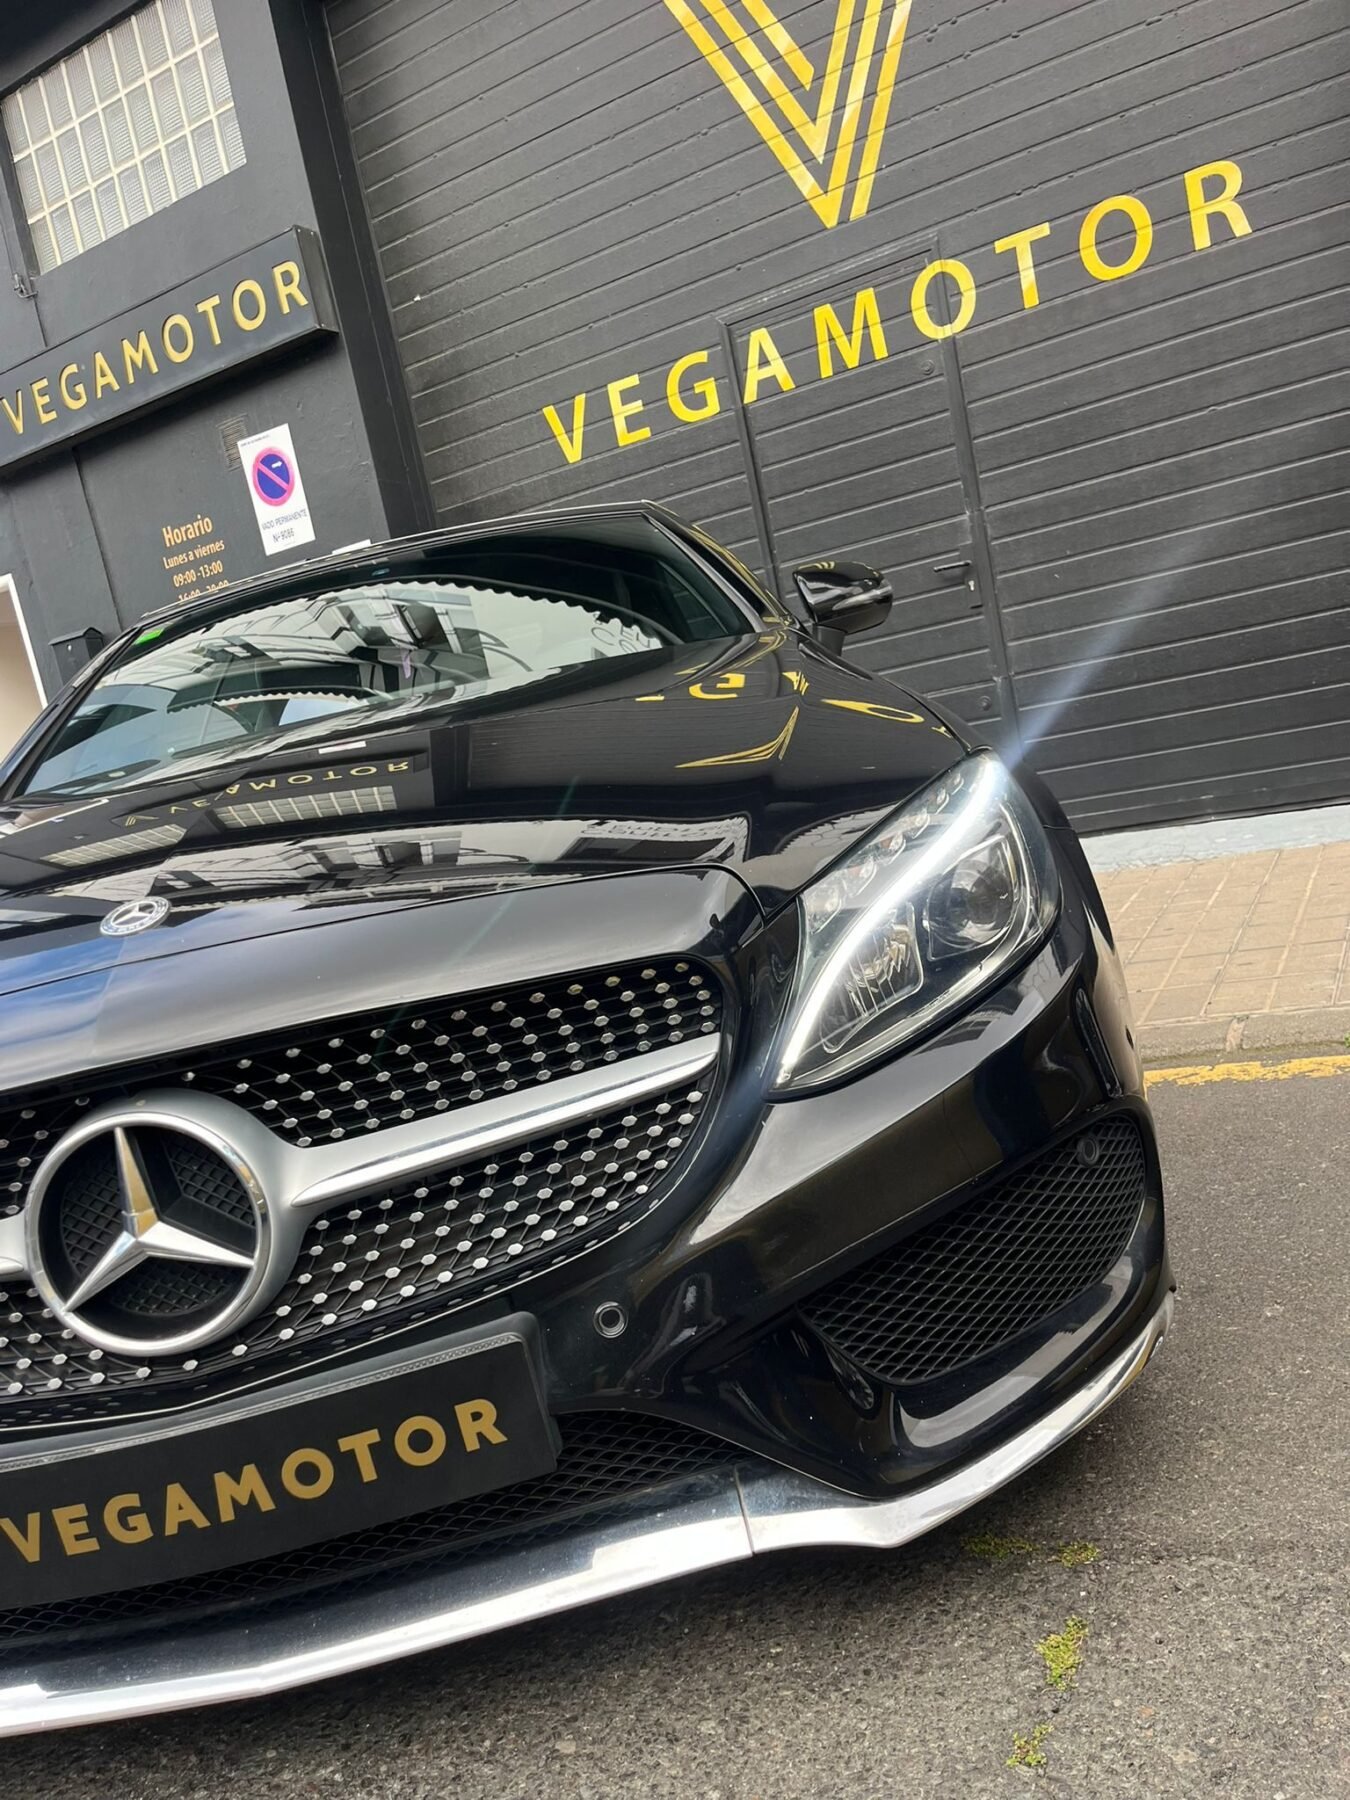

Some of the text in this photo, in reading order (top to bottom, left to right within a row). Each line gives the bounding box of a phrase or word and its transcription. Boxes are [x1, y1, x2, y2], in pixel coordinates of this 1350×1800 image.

[0, 260, 309, 435] VEGAMOTOR
[542, 160, 1251, 464] VEGAMOTOR
[162, 514, 213, 547] Horario
[162, 540, 225, 569] Lunes a viernes
[173, 569, 197, 587] 09:00
[0, 1398, 508, 1563] VEGAMOTOR
